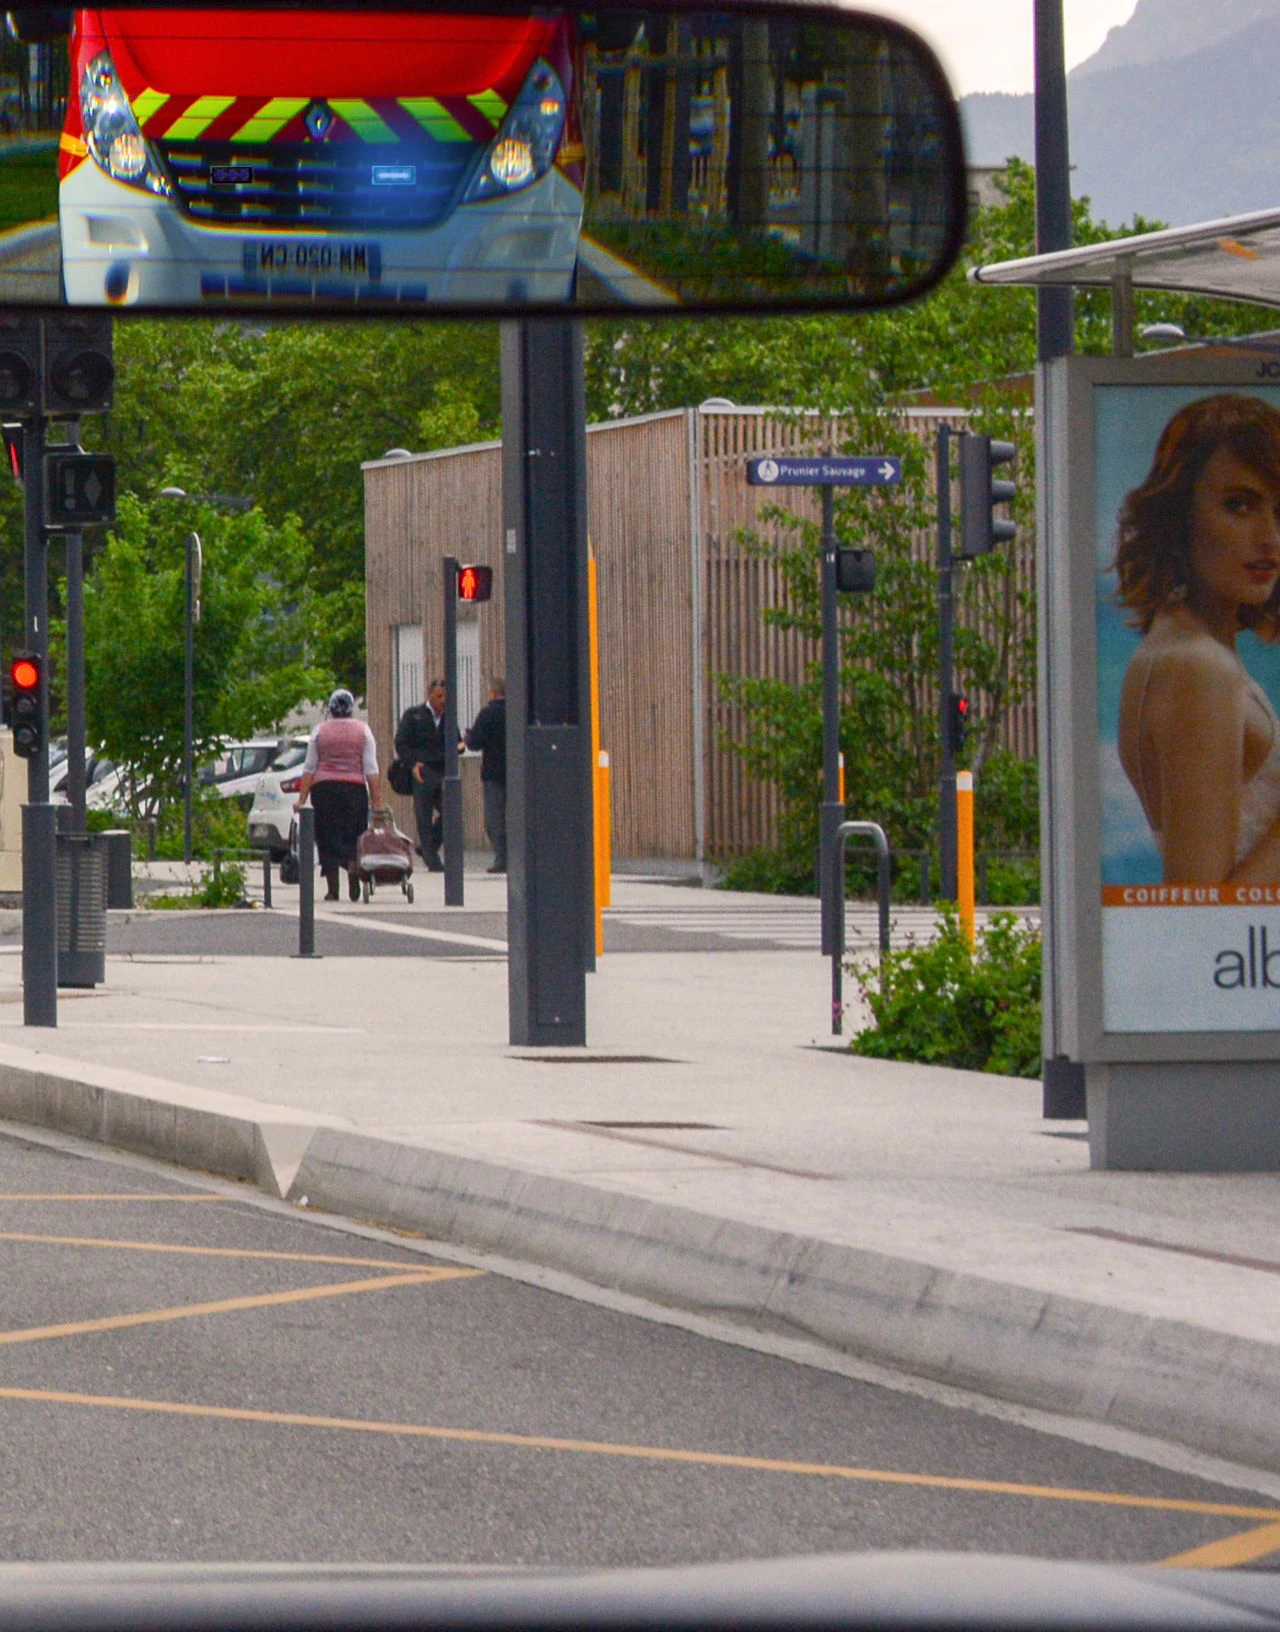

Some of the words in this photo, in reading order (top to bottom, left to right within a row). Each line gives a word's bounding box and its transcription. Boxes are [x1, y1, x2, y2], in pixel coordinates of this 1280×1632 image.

[780, 465, 819, 476] Prunier
[822, 465, 866, 479] Sauvage
[1123, 887, 1221, 903] COIFFEUR
